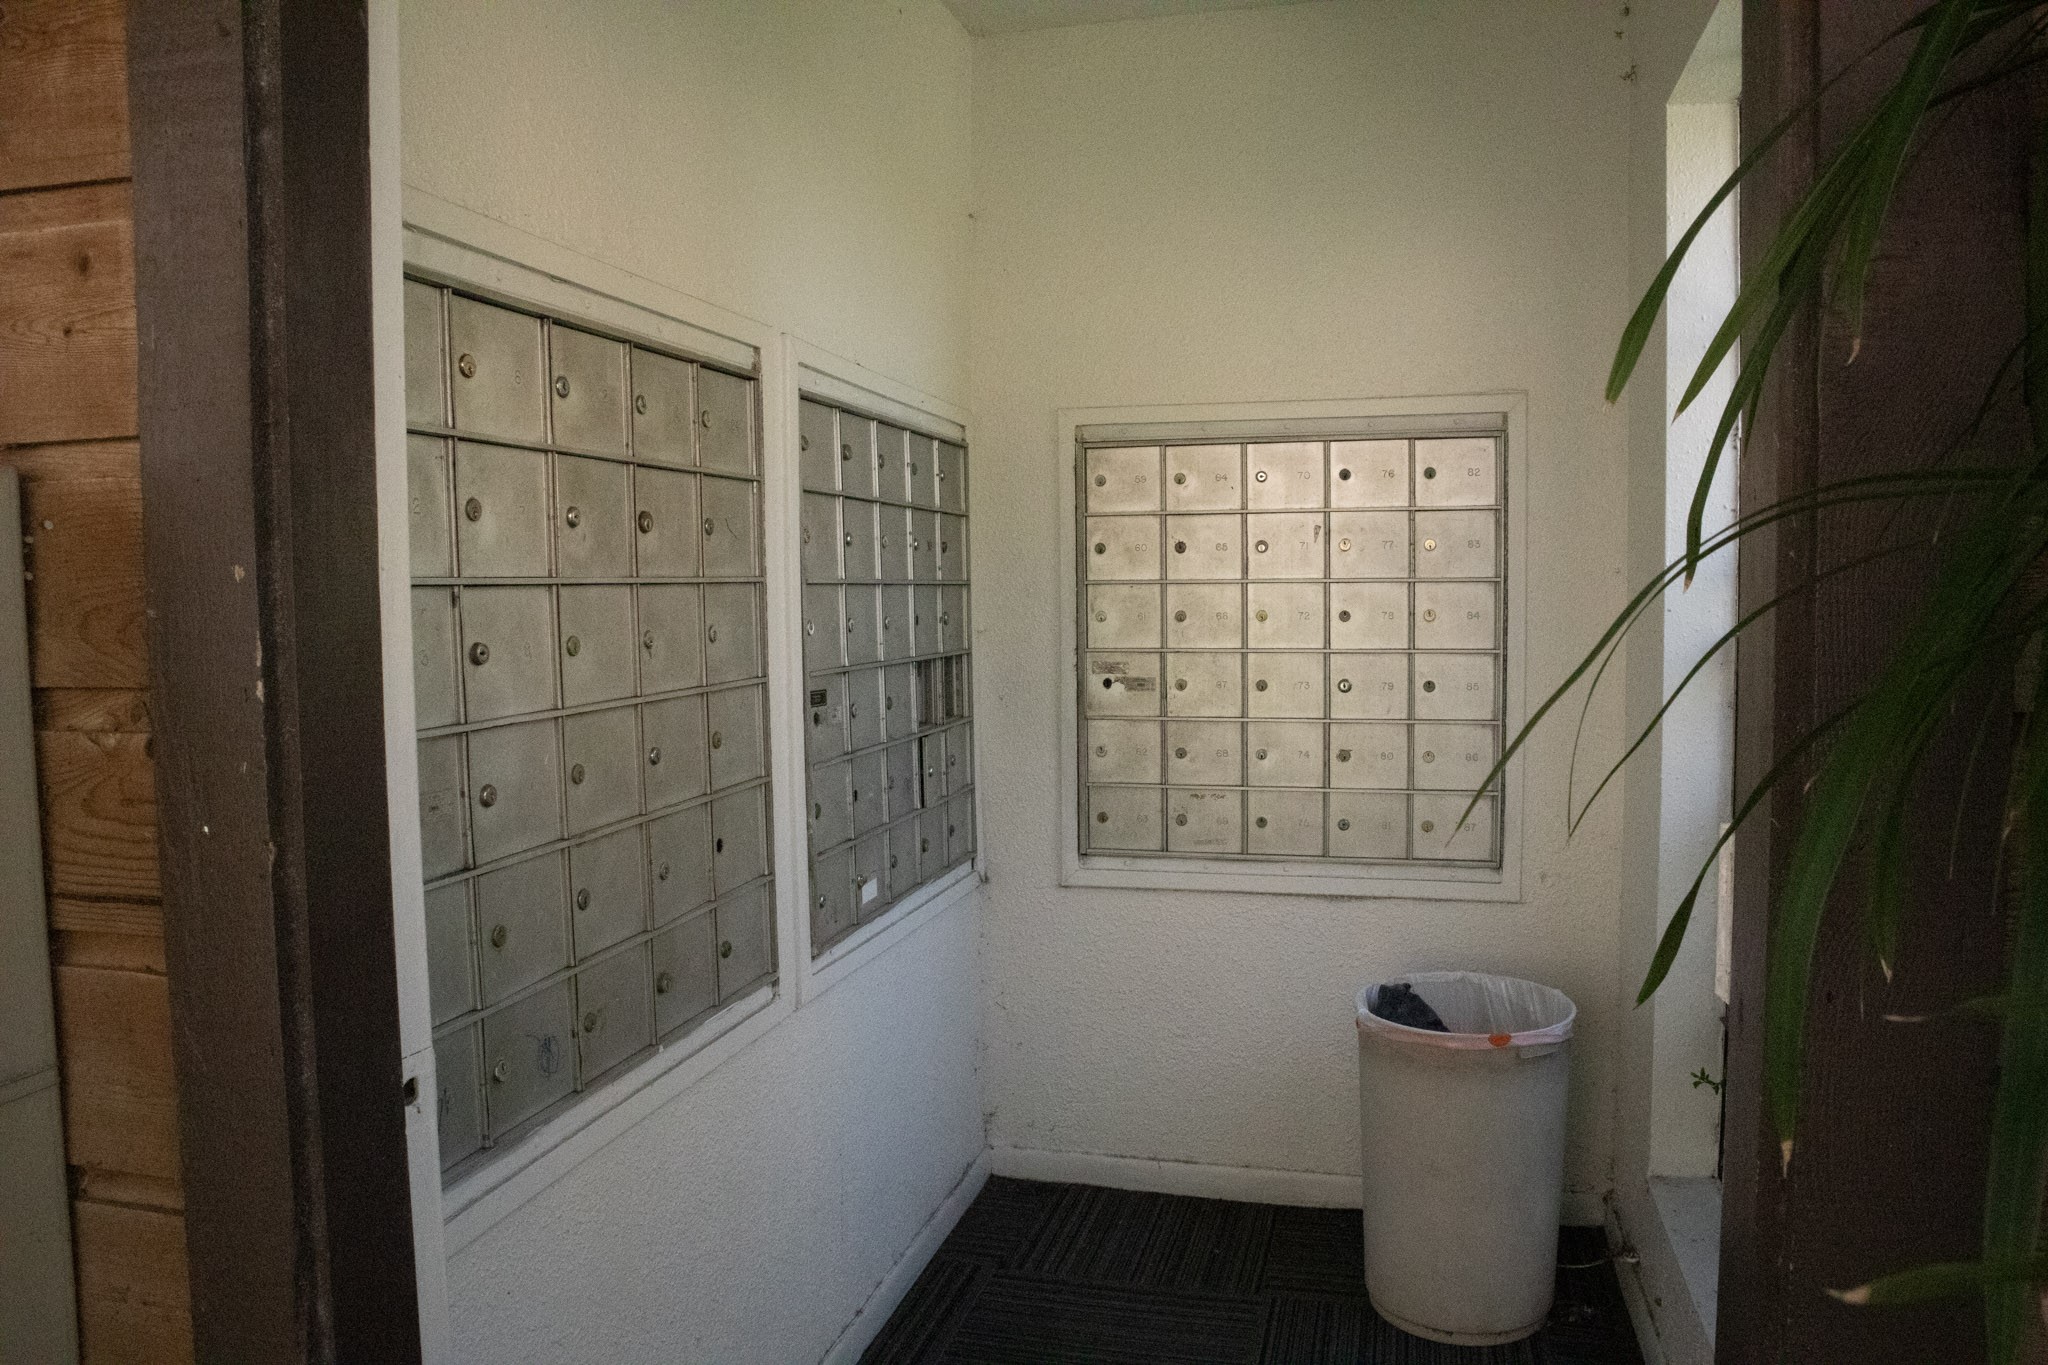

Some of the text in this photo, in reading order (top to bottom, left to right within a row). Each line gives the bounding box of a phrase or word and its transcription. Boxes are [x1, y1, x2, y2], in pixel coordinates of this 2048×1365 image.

[1297, 471, 1311, 480] 70
[1382, 469, 1395, 479] 76
[1467, 467, 1481, 477] 82
[1134, 543, 1148, 552] 60
[1299, 541, 1309, 551] 71
[1382, 540, 1394, 550] 77
[1467, 539, 1481, 549] 83
[1136, 611, 1147, 622] 61
[1297, 611, 1310, 621] 72
[1381, 611, 1395, 621] 78
[1466, 611, 1481, 620] 84
[1297, 681, 1310, 690] 73
[1381, 681, 1395, 691] 79
[1466, 682, 1480, 691] 85
[1298, 750, 1310, 759] 74
[1380, 751, 1395, 761] 80
